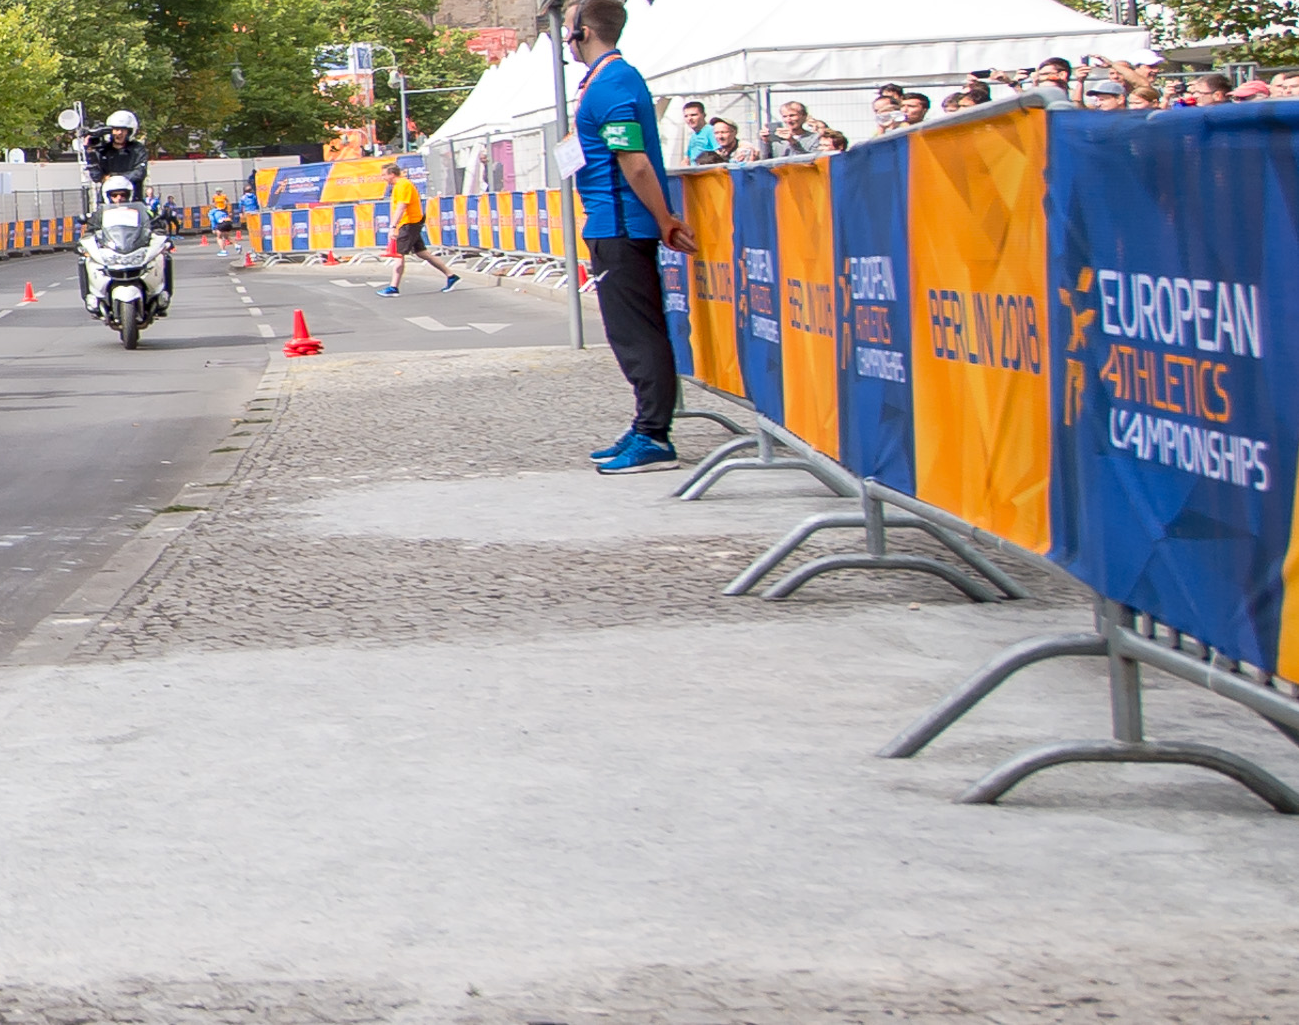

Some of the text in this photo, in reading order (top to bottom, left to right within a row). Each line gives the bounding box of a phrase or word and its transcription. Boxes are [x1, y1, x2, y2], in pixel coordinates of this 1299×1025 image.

[928, 288, 1041, 375] BERLIN 2018
[1097, 268, 1264, 360] EUROPEAN
[1099, 343, 1232, 424] ATHLETICS
